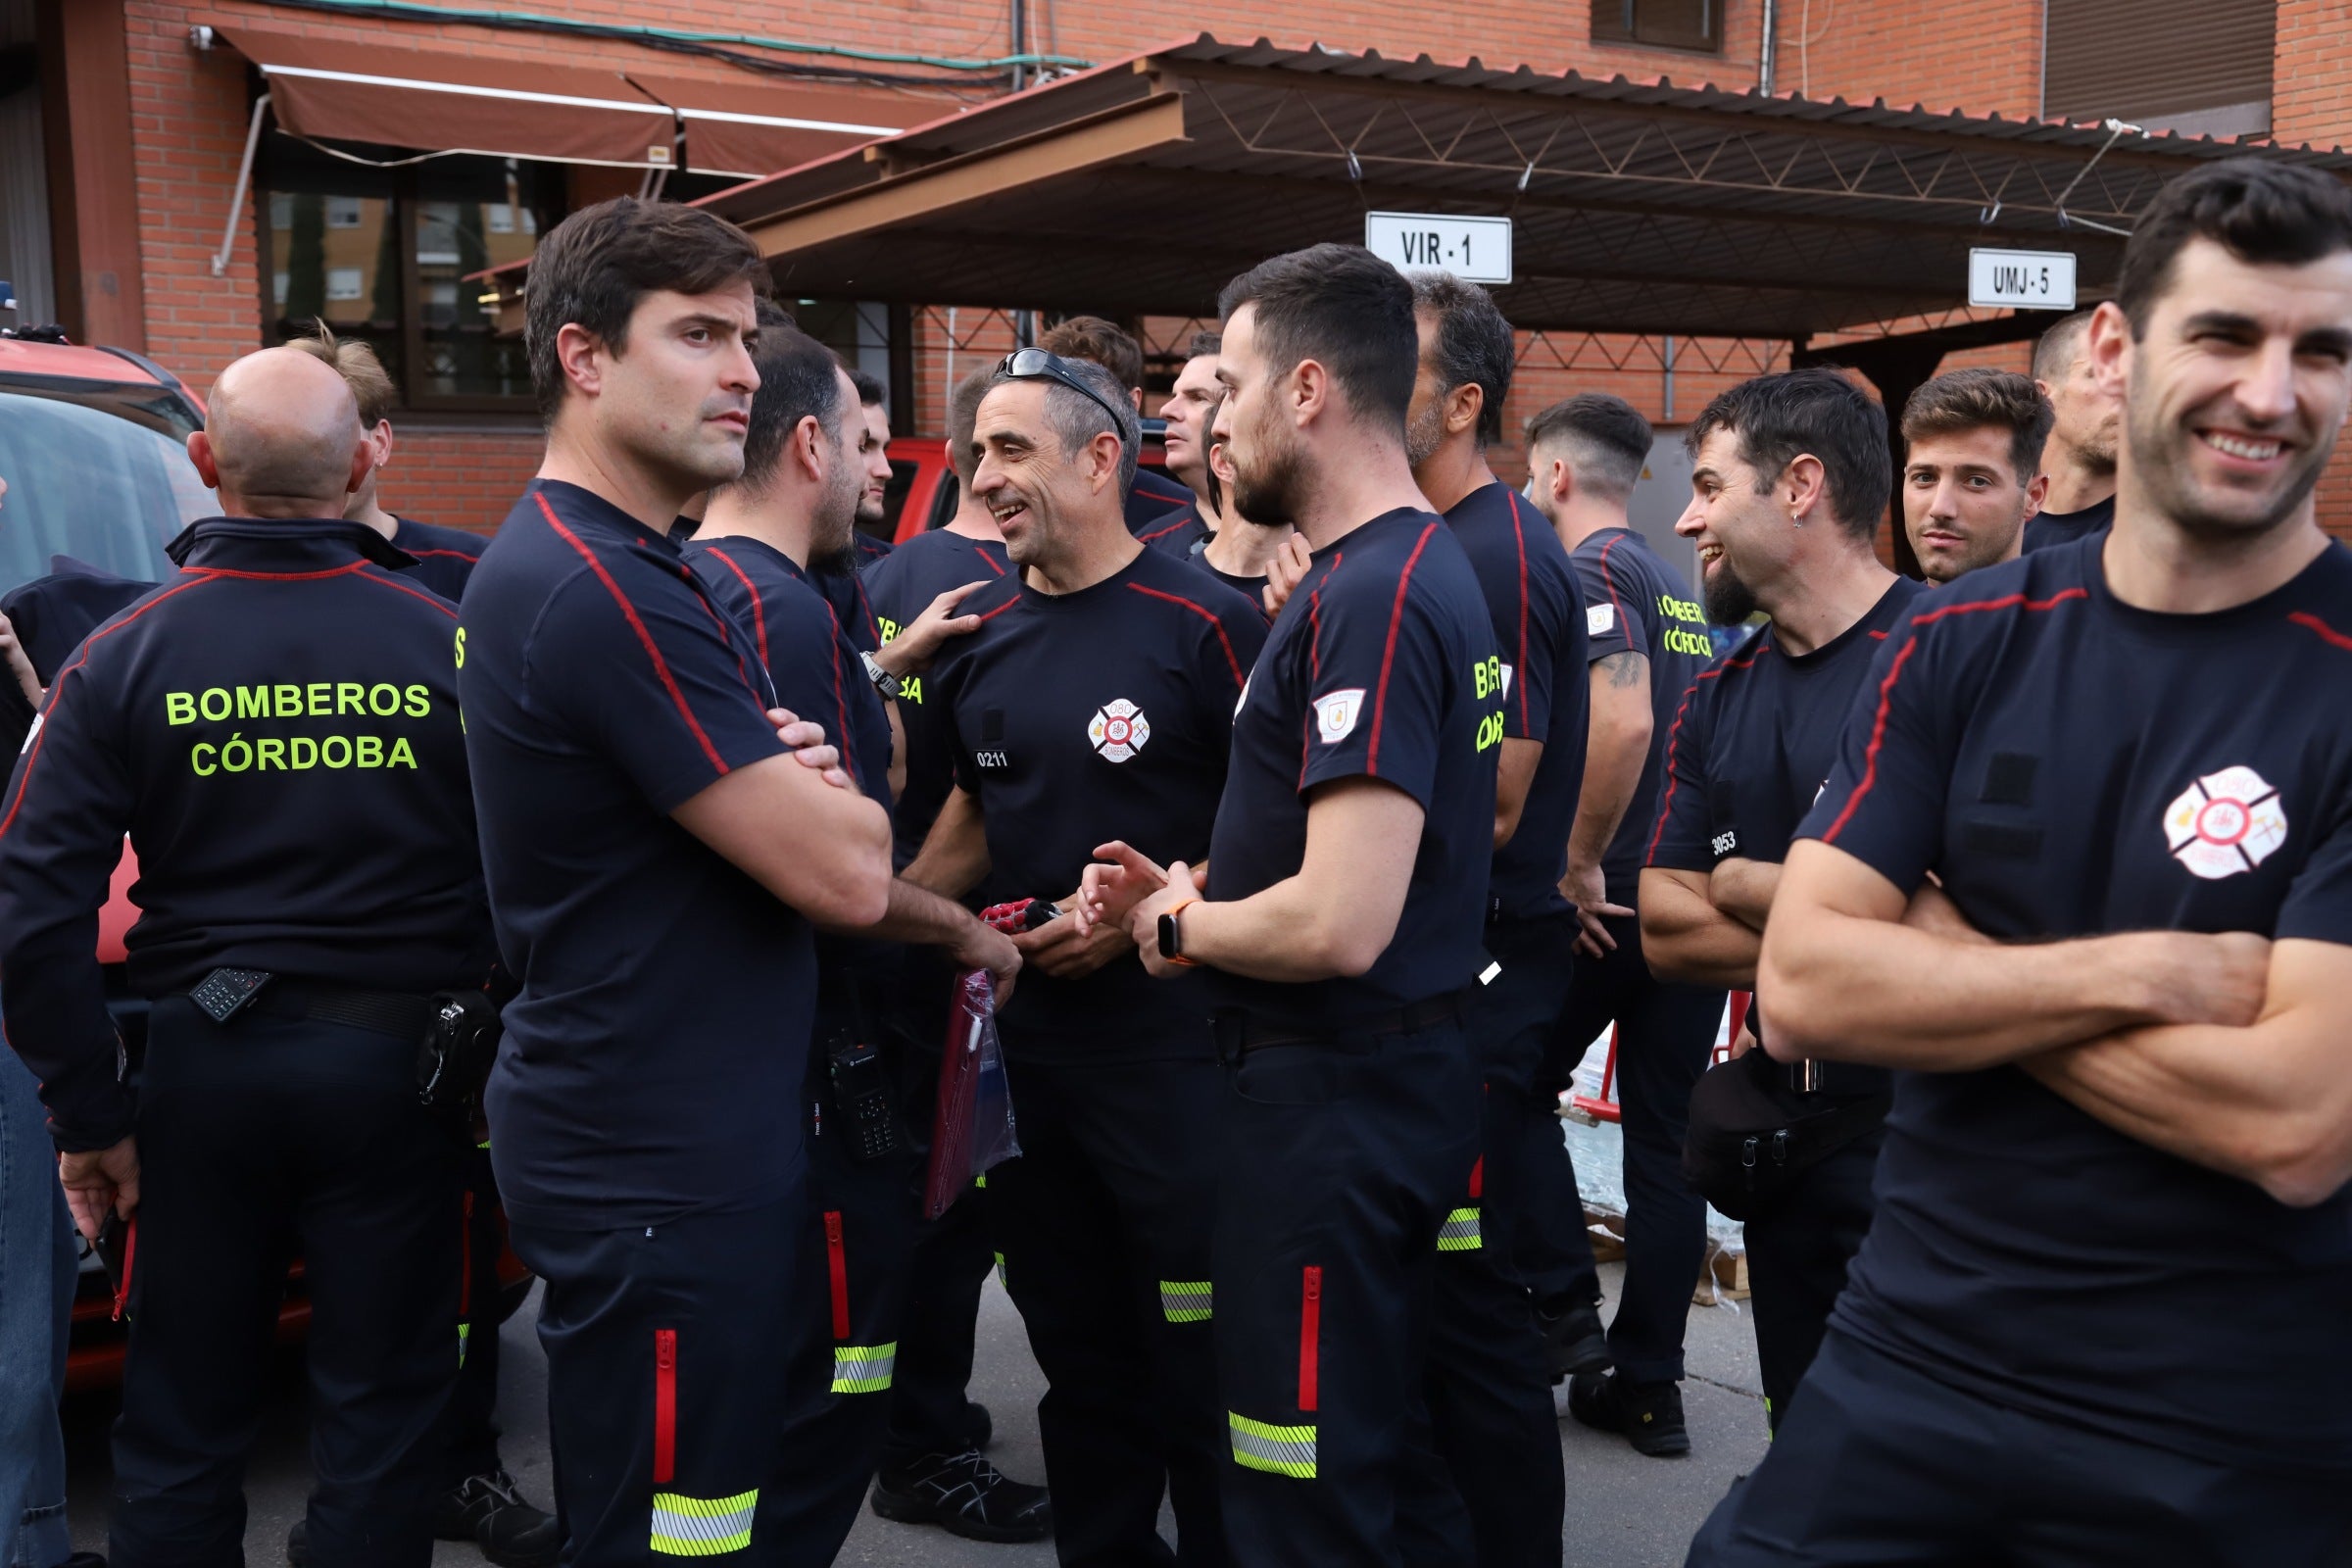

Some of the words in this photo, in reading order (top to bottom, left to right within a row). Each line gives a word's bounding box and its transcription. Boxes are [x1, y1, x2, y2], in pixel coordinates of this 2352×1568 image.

[1401, 231, 1441, 265] VIR
[1993, 266, 2028, 295] UMJ
[166, 682, 431, 726] BOMBEROS
[191, 731, 419, 777] CÓRDOBA
[976, 751, 1008, 767] 0211
[1711, 830, 1737, 856] 3053
